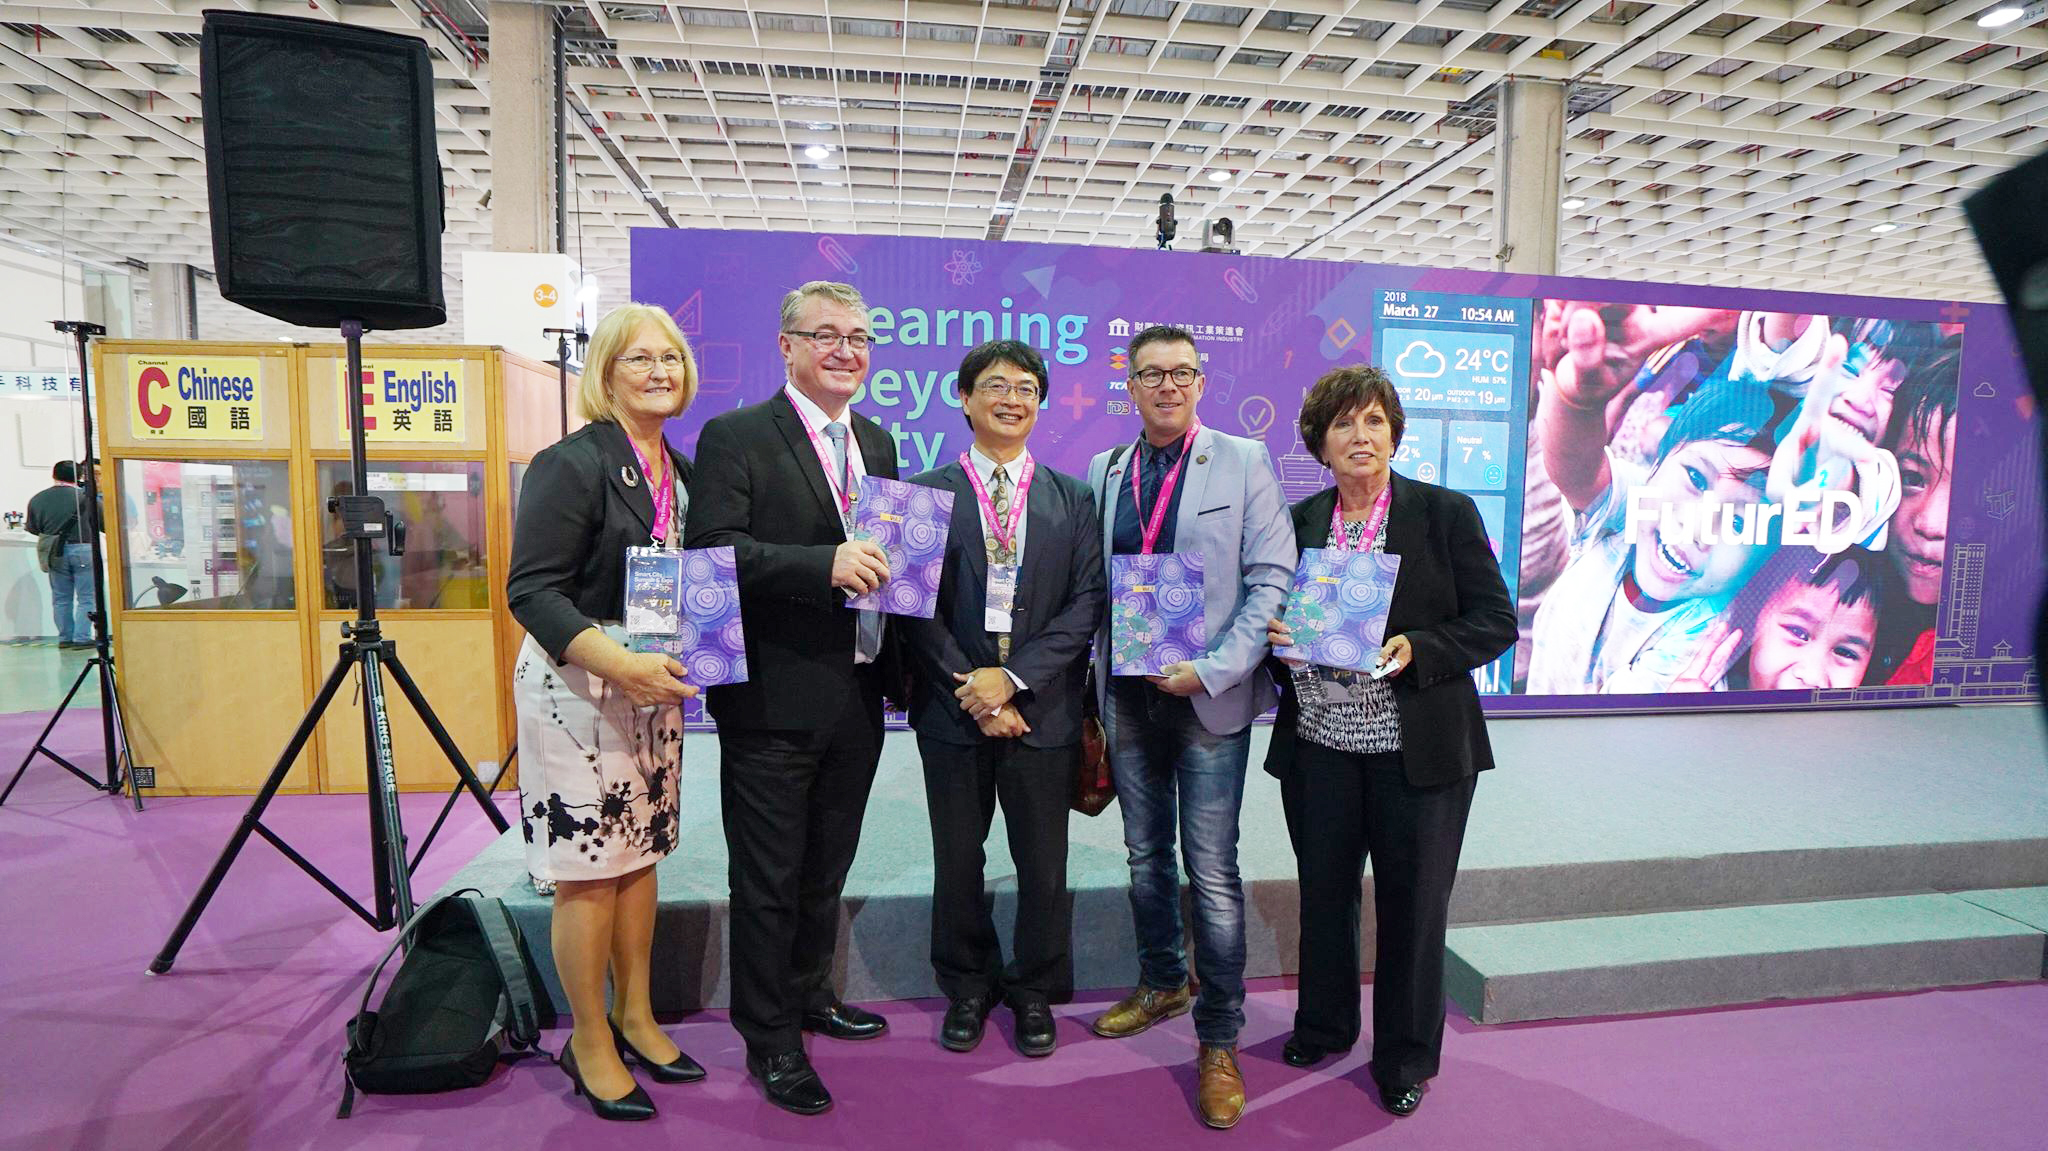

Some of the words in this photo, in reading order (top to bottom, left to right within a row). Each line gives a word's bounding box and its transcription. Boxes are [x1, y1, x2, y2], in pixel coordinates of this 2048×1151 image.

[535, 288, 557, 302] 3-4
[1384, 291, 1407, 302] 2018
[1383, 303, 1419, 317] March
[1424, 306, 1439, 318] 27
[1461, 308, 1492, 321] 10:54
[1495, 310, 1514, 322] AM
[868, 297, 1089, 365] earning
[1455, 348, 1509, 372] 24°C
[178, 366, 254, 401] Chinese
[1472, 375, 1489, 384] HUM
[1492, 376, 1507, 384] 57%
[137, 366, 172, 429] C
[384, 370, 457, 412] English
[1415, 388, 1431, 401] 20
[1478, 390, 1493, 405] 19
[1456, 436, 1483, 445] Neutral
[1462, 446, 1473, 463] 7
[1482, 450, 1492, 460] %
[1624, 485, 1862, 547] FuturED
[376, 711, 390, 745] KING
[383, 747, 398, 793] STAGE
